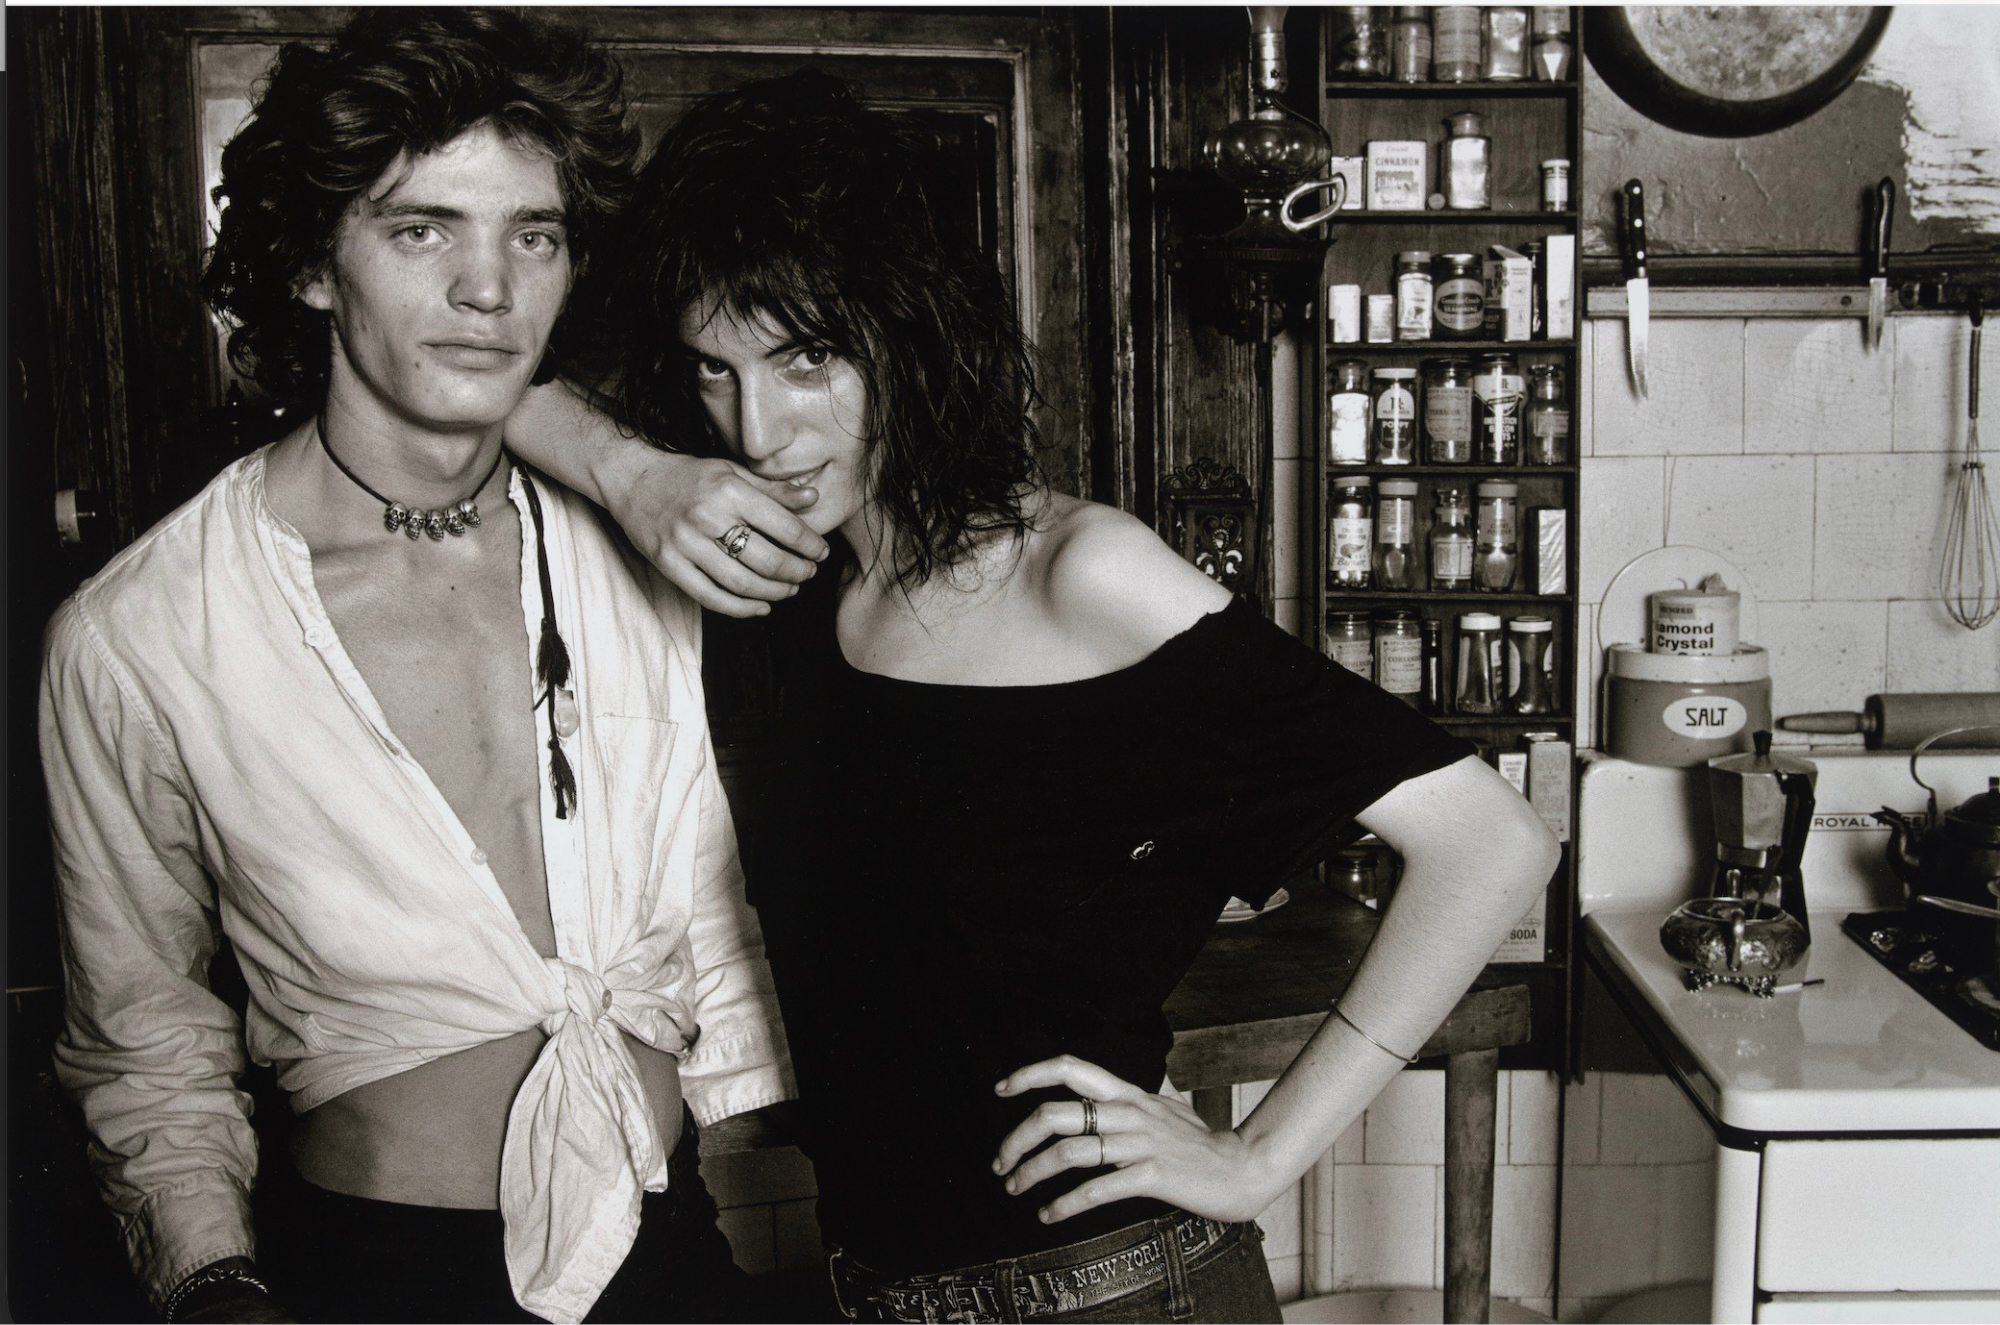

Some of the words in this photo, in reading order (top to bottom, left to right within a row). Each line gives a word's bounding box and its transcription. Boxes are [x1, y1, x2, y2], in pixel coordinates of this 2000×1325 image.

[1375, 157, 1419, 166] CINNAMON
[1382, 421, 1409, 429] POPY
[1656, 635, 1714, 651] Crystal
[1685, 708, 1728, 726] SALT
[1814, 817, 1870, 828] ROYAL
[1509, 929, 1538, 940] SODA
[1072, 1258, 1118, 1288] NEW
